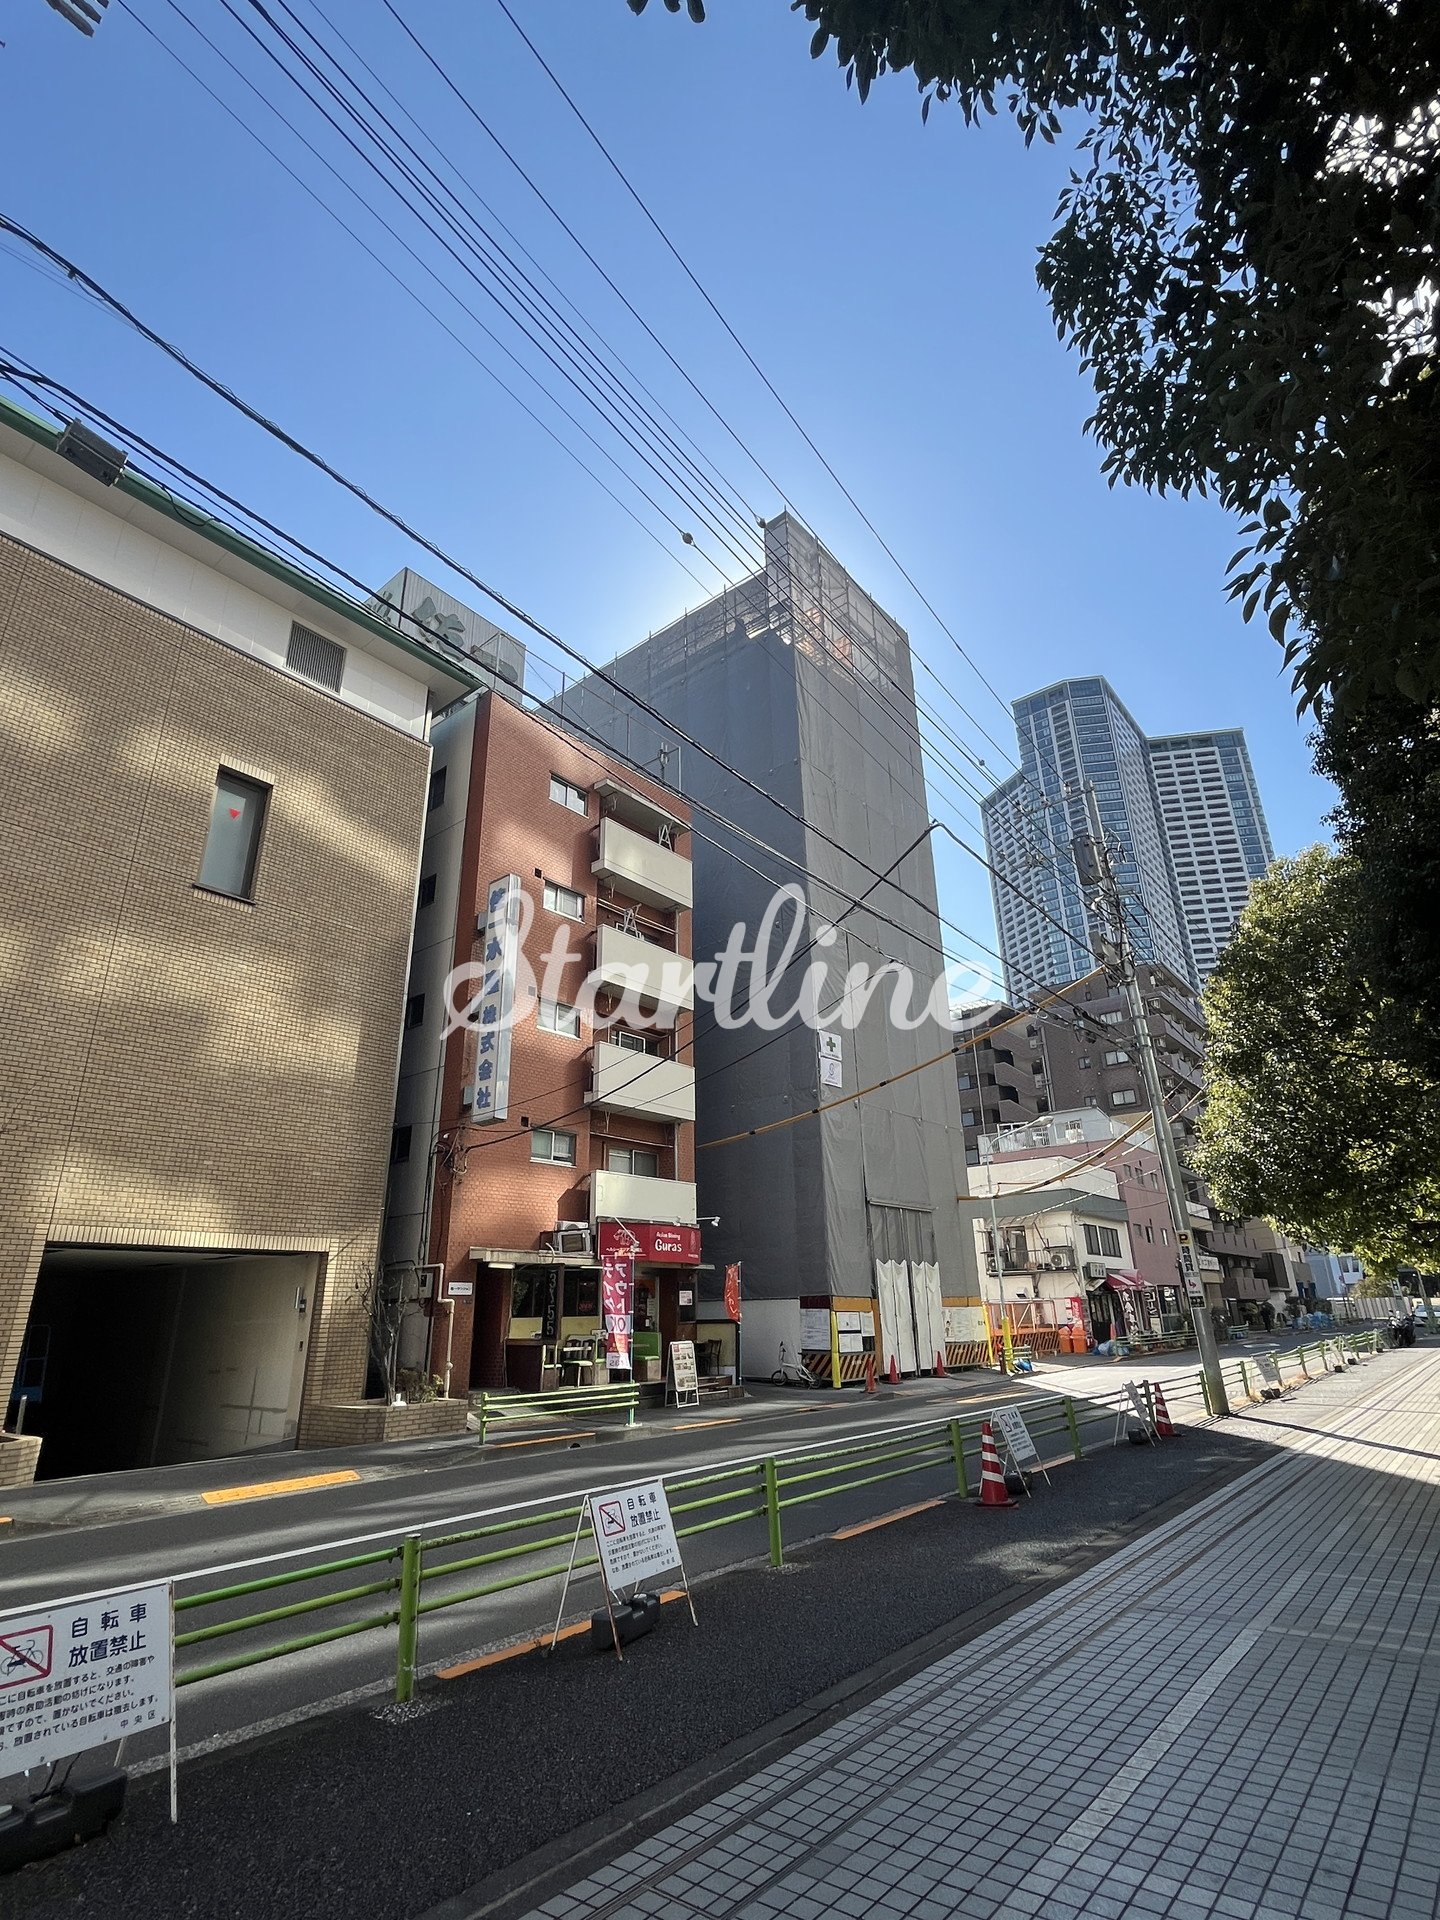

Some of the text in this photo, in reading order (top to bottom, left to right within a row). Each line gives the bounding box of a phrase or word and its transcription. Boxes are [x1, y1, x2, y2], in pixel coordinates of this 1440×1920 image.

[655, 1238, 682, 1253] Guras
[72, 1603, 147, 1639] 自転車
[68, 1630, 147, 1668] 放置禁止
